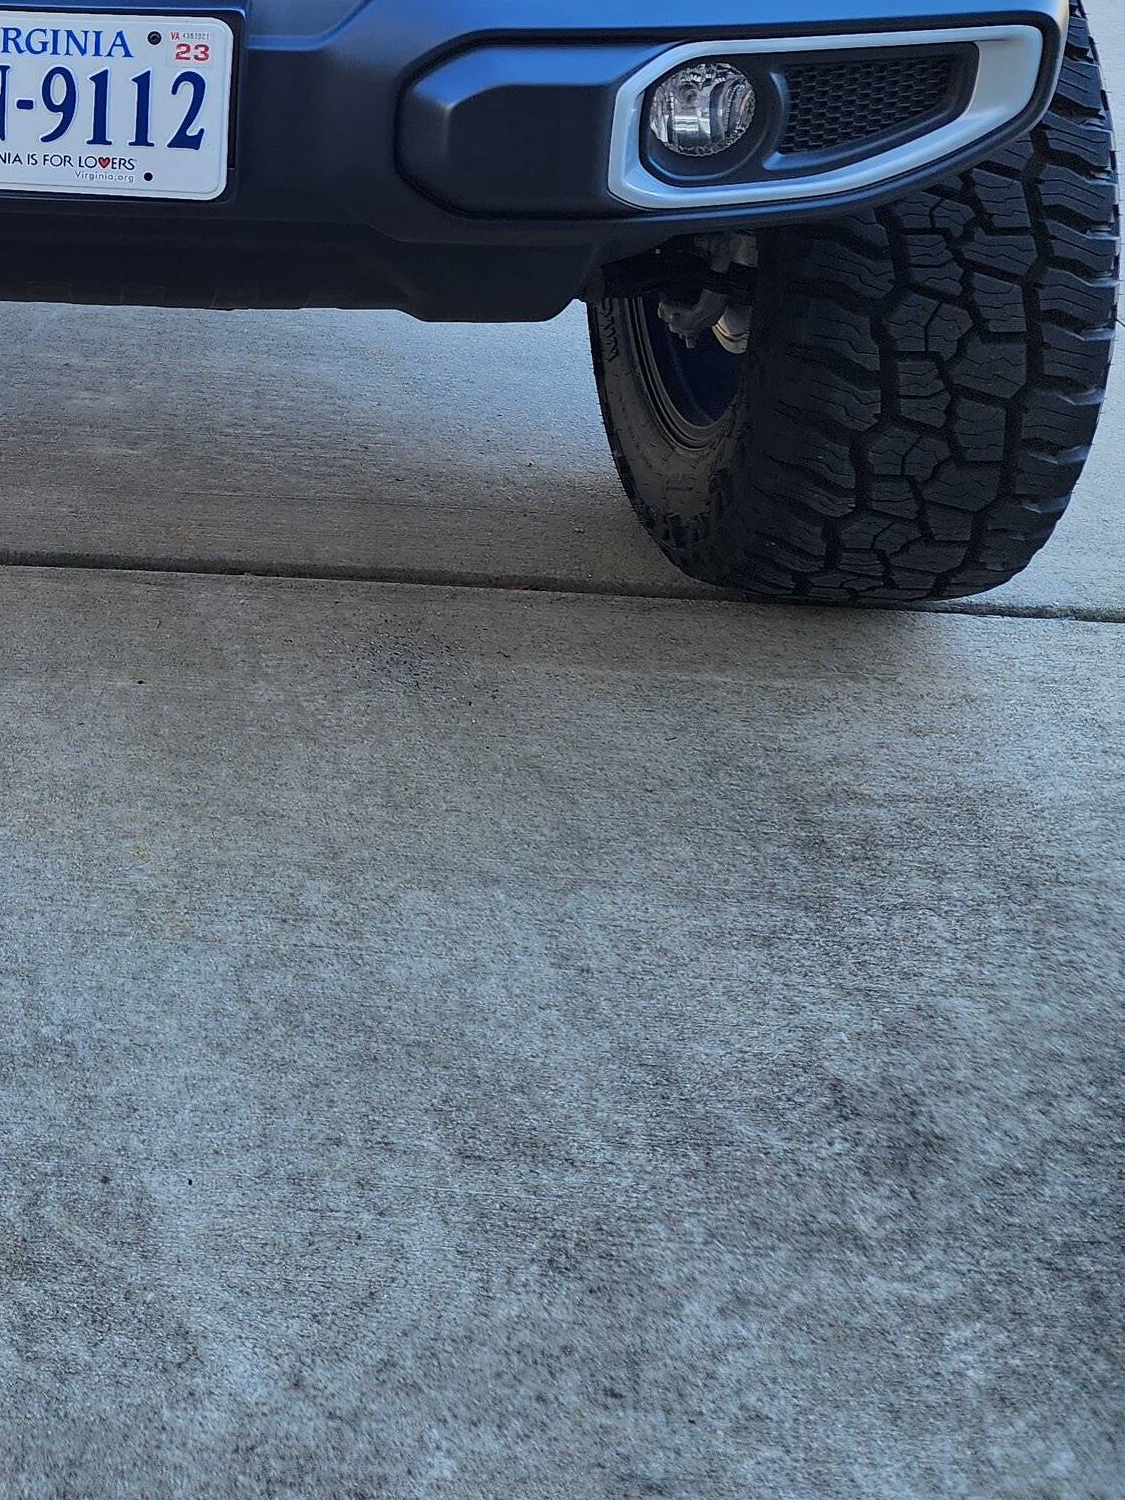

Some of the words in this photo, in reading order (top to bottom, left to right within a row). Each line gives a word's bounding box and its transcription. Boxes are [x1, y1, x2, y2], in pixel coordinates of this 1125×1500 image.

[170, 32, 180, 40] VA
[175, 43, 210, 61] 23
[27, 153, 39, 166] IS
[43, 154, 74, 168] FOR
[75, 170, 135, 183] Virginia.org
